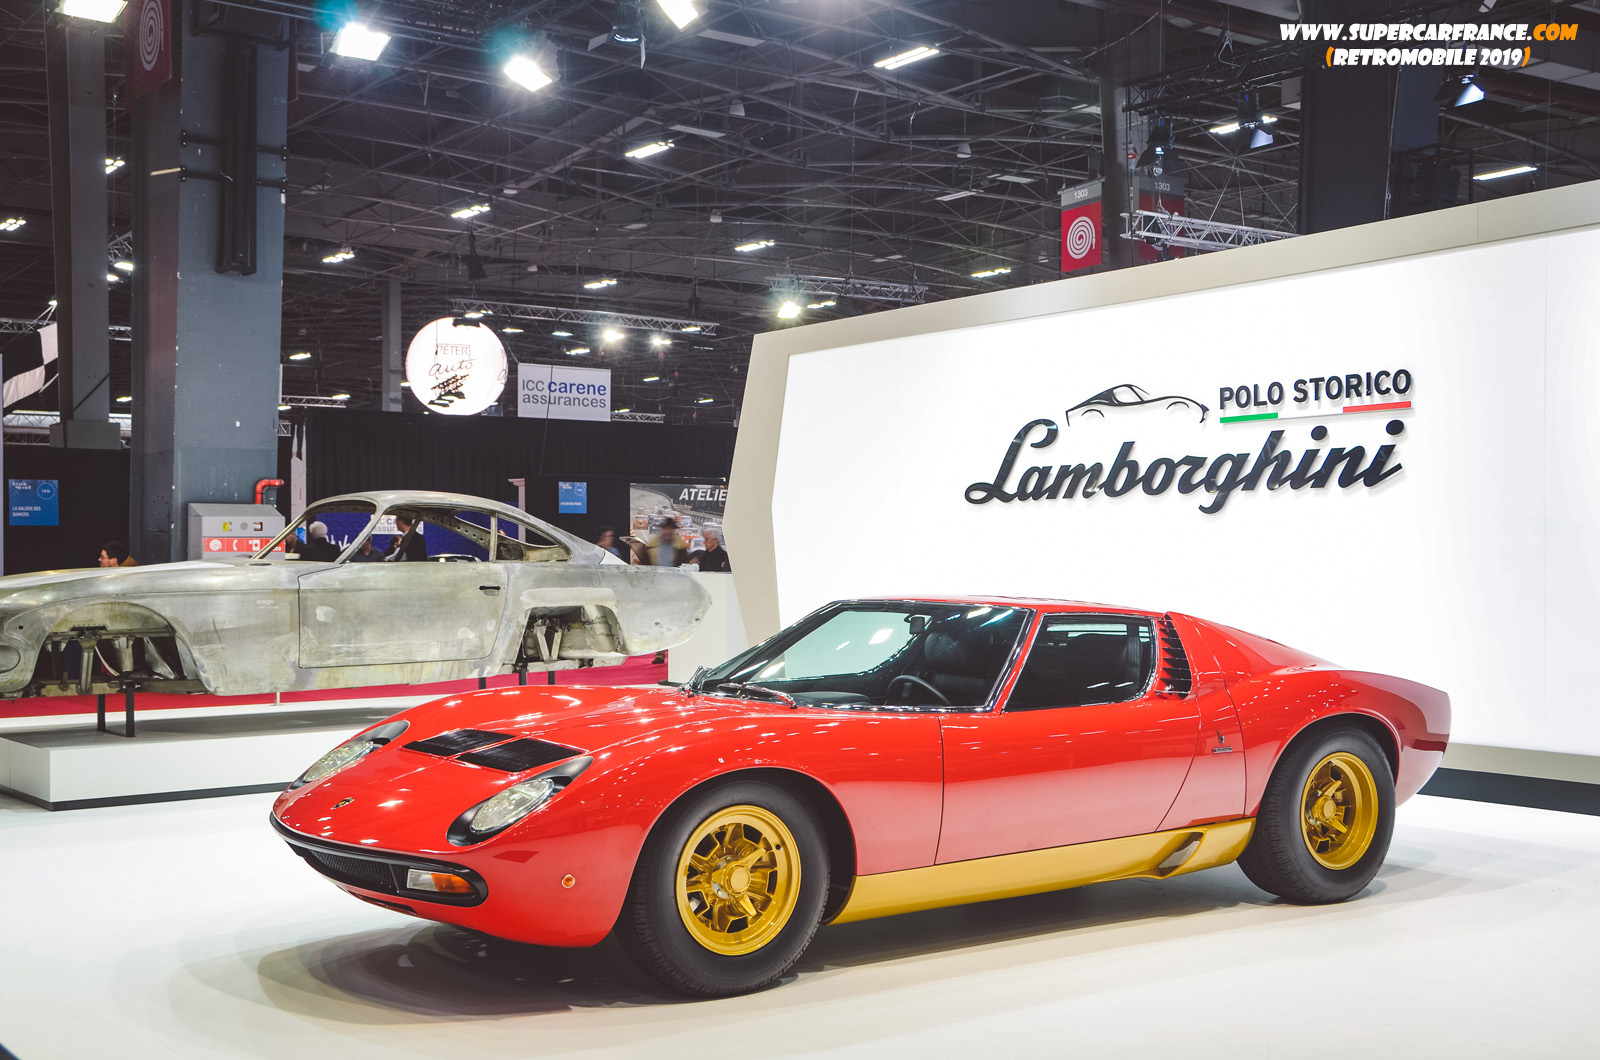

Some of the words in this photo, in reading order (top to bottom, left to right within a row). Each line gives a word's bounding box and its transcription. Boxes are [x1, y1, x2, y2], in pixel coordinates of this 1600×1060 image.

[1074, 189, 1088, 200] 1303
[1155, 182, 1171, 191] 1303
[437, 345, 469, 356] PETER
[522, 379, 545, 392] ICC
[547, 381, 607, 396] carene
[1220, 381, 1284, 410] POLO
[1293, 369, 1412, 403] STORICO
[522, 393, 606, 409] assurances
[964, 419, 1405, 514] Lamborghini
